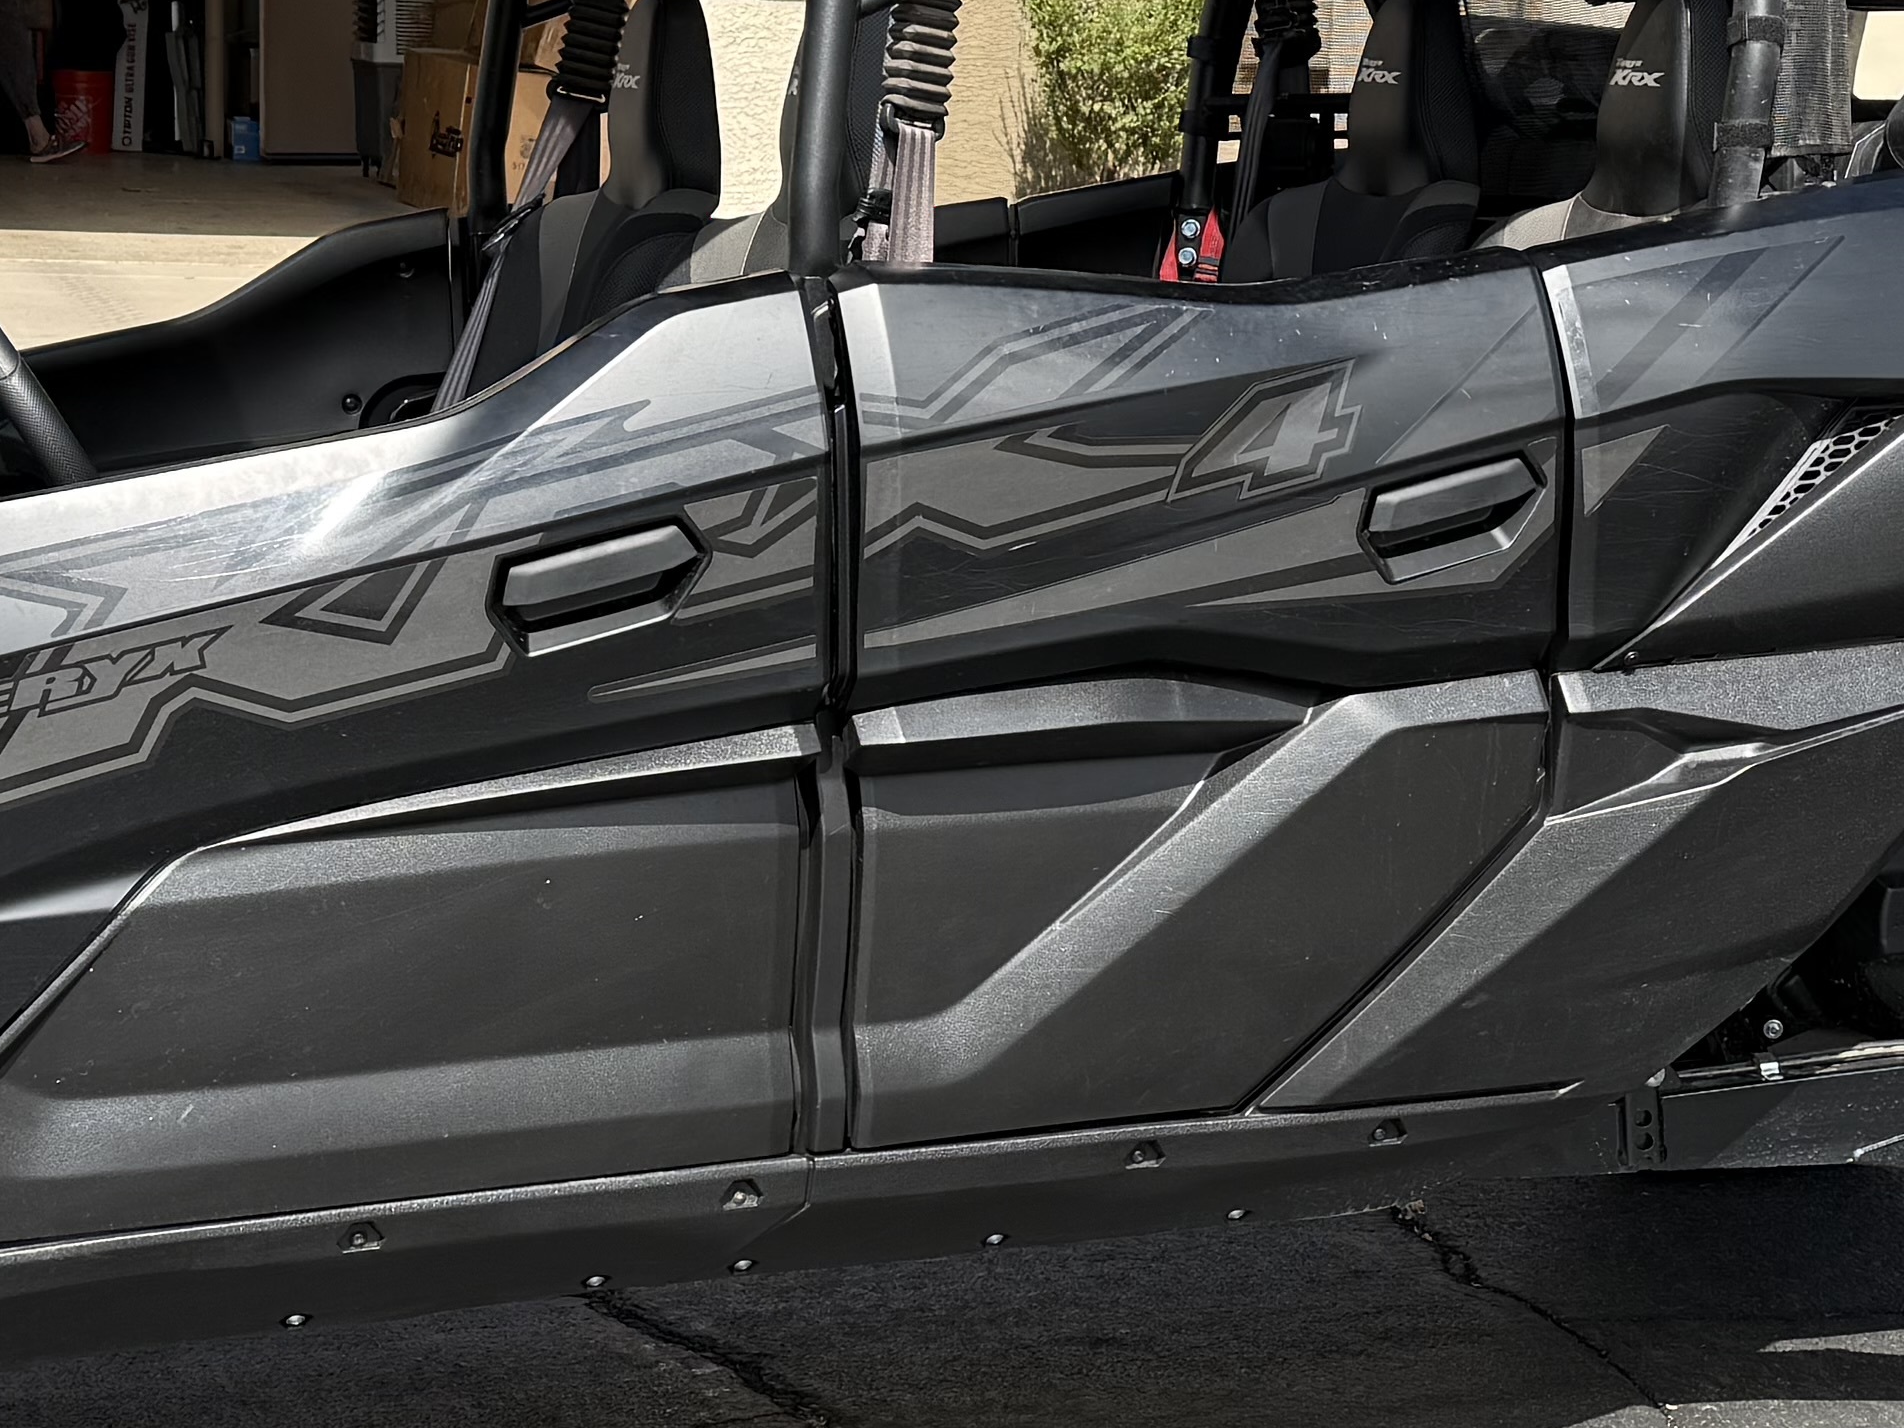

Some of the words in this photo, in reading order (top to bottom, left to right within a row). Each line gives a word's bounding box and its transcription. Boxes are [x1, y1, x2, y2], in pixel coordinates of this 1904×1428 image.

[1357, 68, 1402, 85] KRX
[1609, 69, 1665, 88] KRX
[1171, 359, 1362, 501] 4
